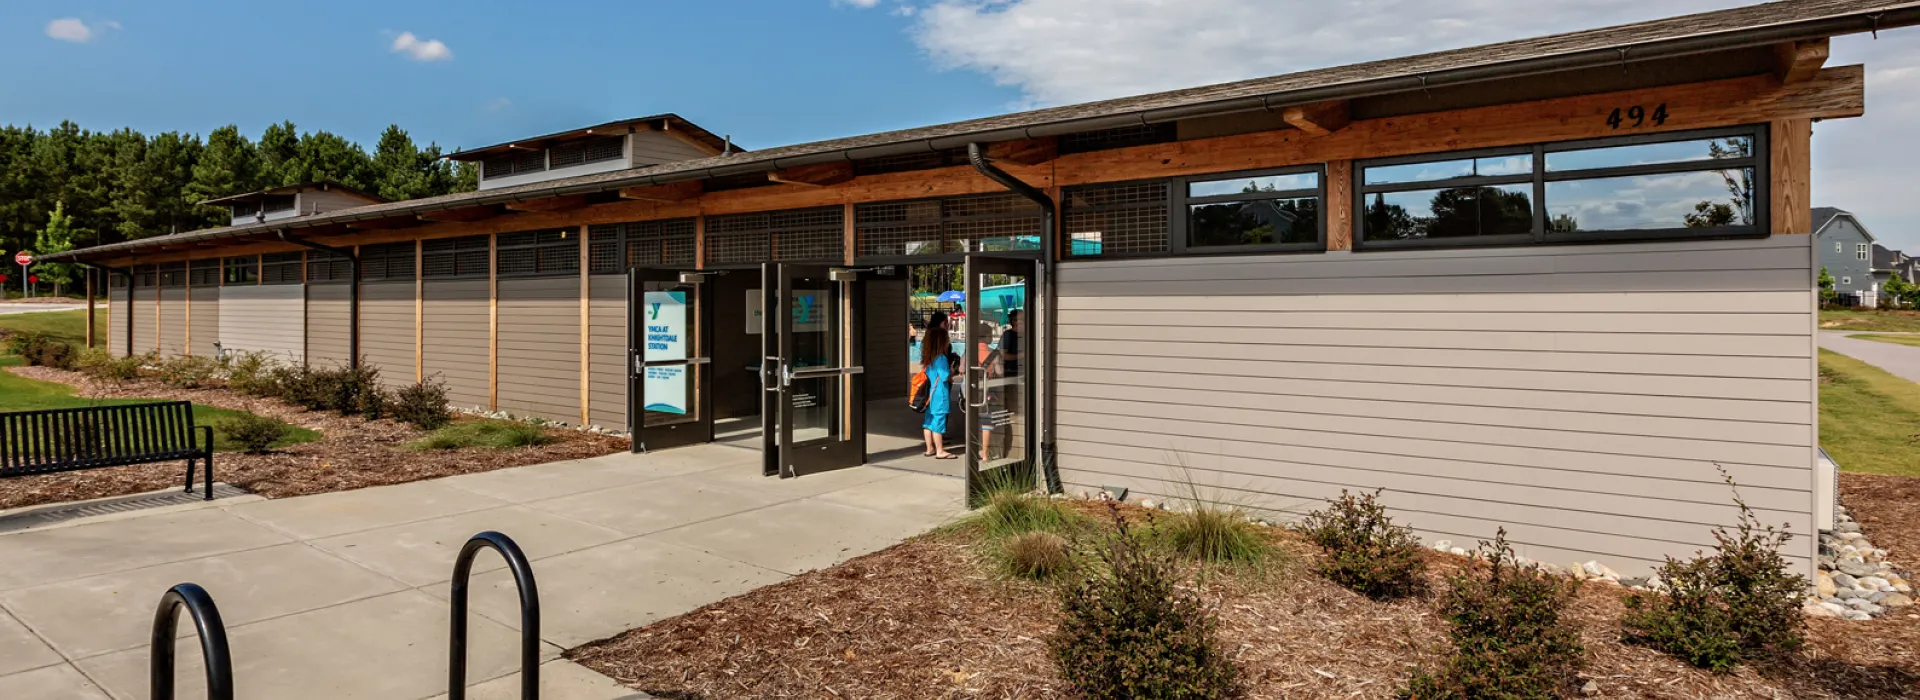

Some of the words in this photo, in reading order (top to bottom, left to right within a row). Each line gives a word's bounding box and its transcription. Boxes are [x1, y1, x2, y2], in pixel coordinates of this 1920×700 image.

[1606, 103, 1669, 129] 494
[647, 325, 661, 333] YMCA
[662, 325, 669, 333] AT
[647, 342, 668, 350] STATION
